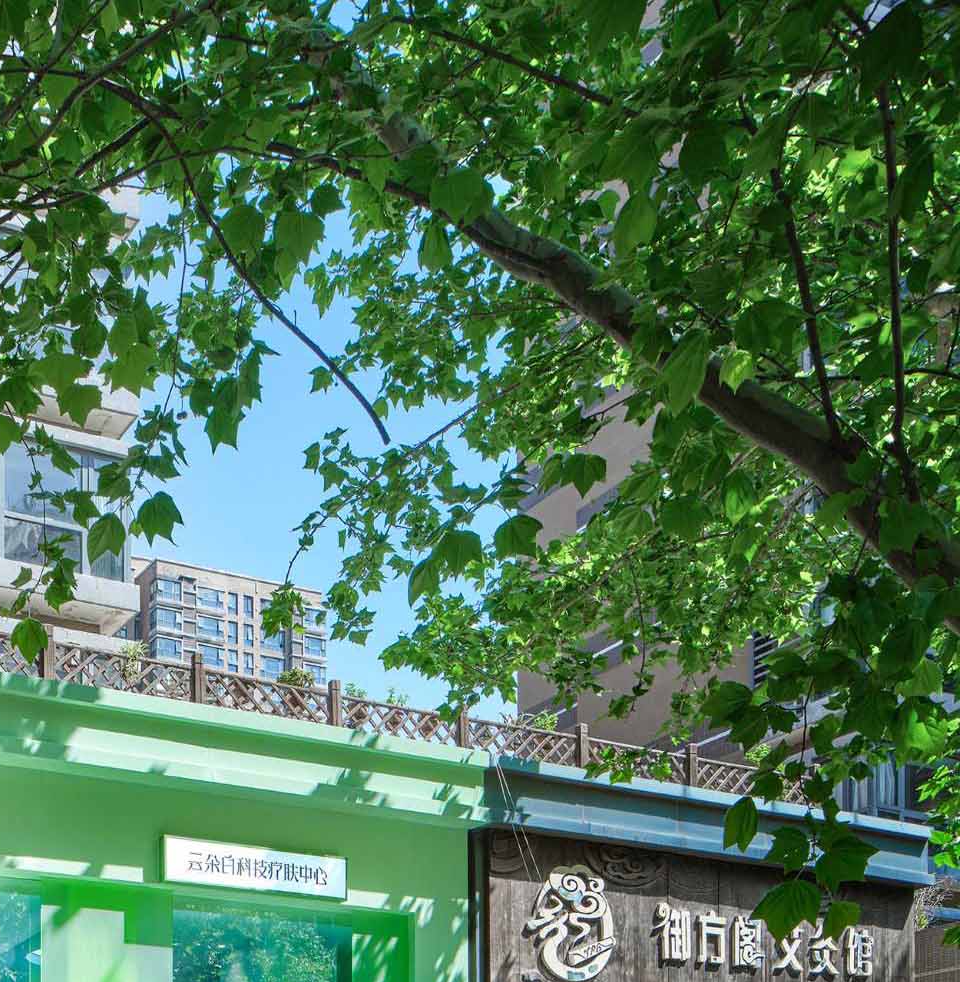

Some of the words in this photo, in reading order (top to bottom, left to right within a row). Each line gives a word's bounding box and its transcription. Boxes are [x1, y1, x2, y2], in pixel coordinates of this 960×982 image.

[187, 851, 328, 887] 云朵白科技疗肤中心
